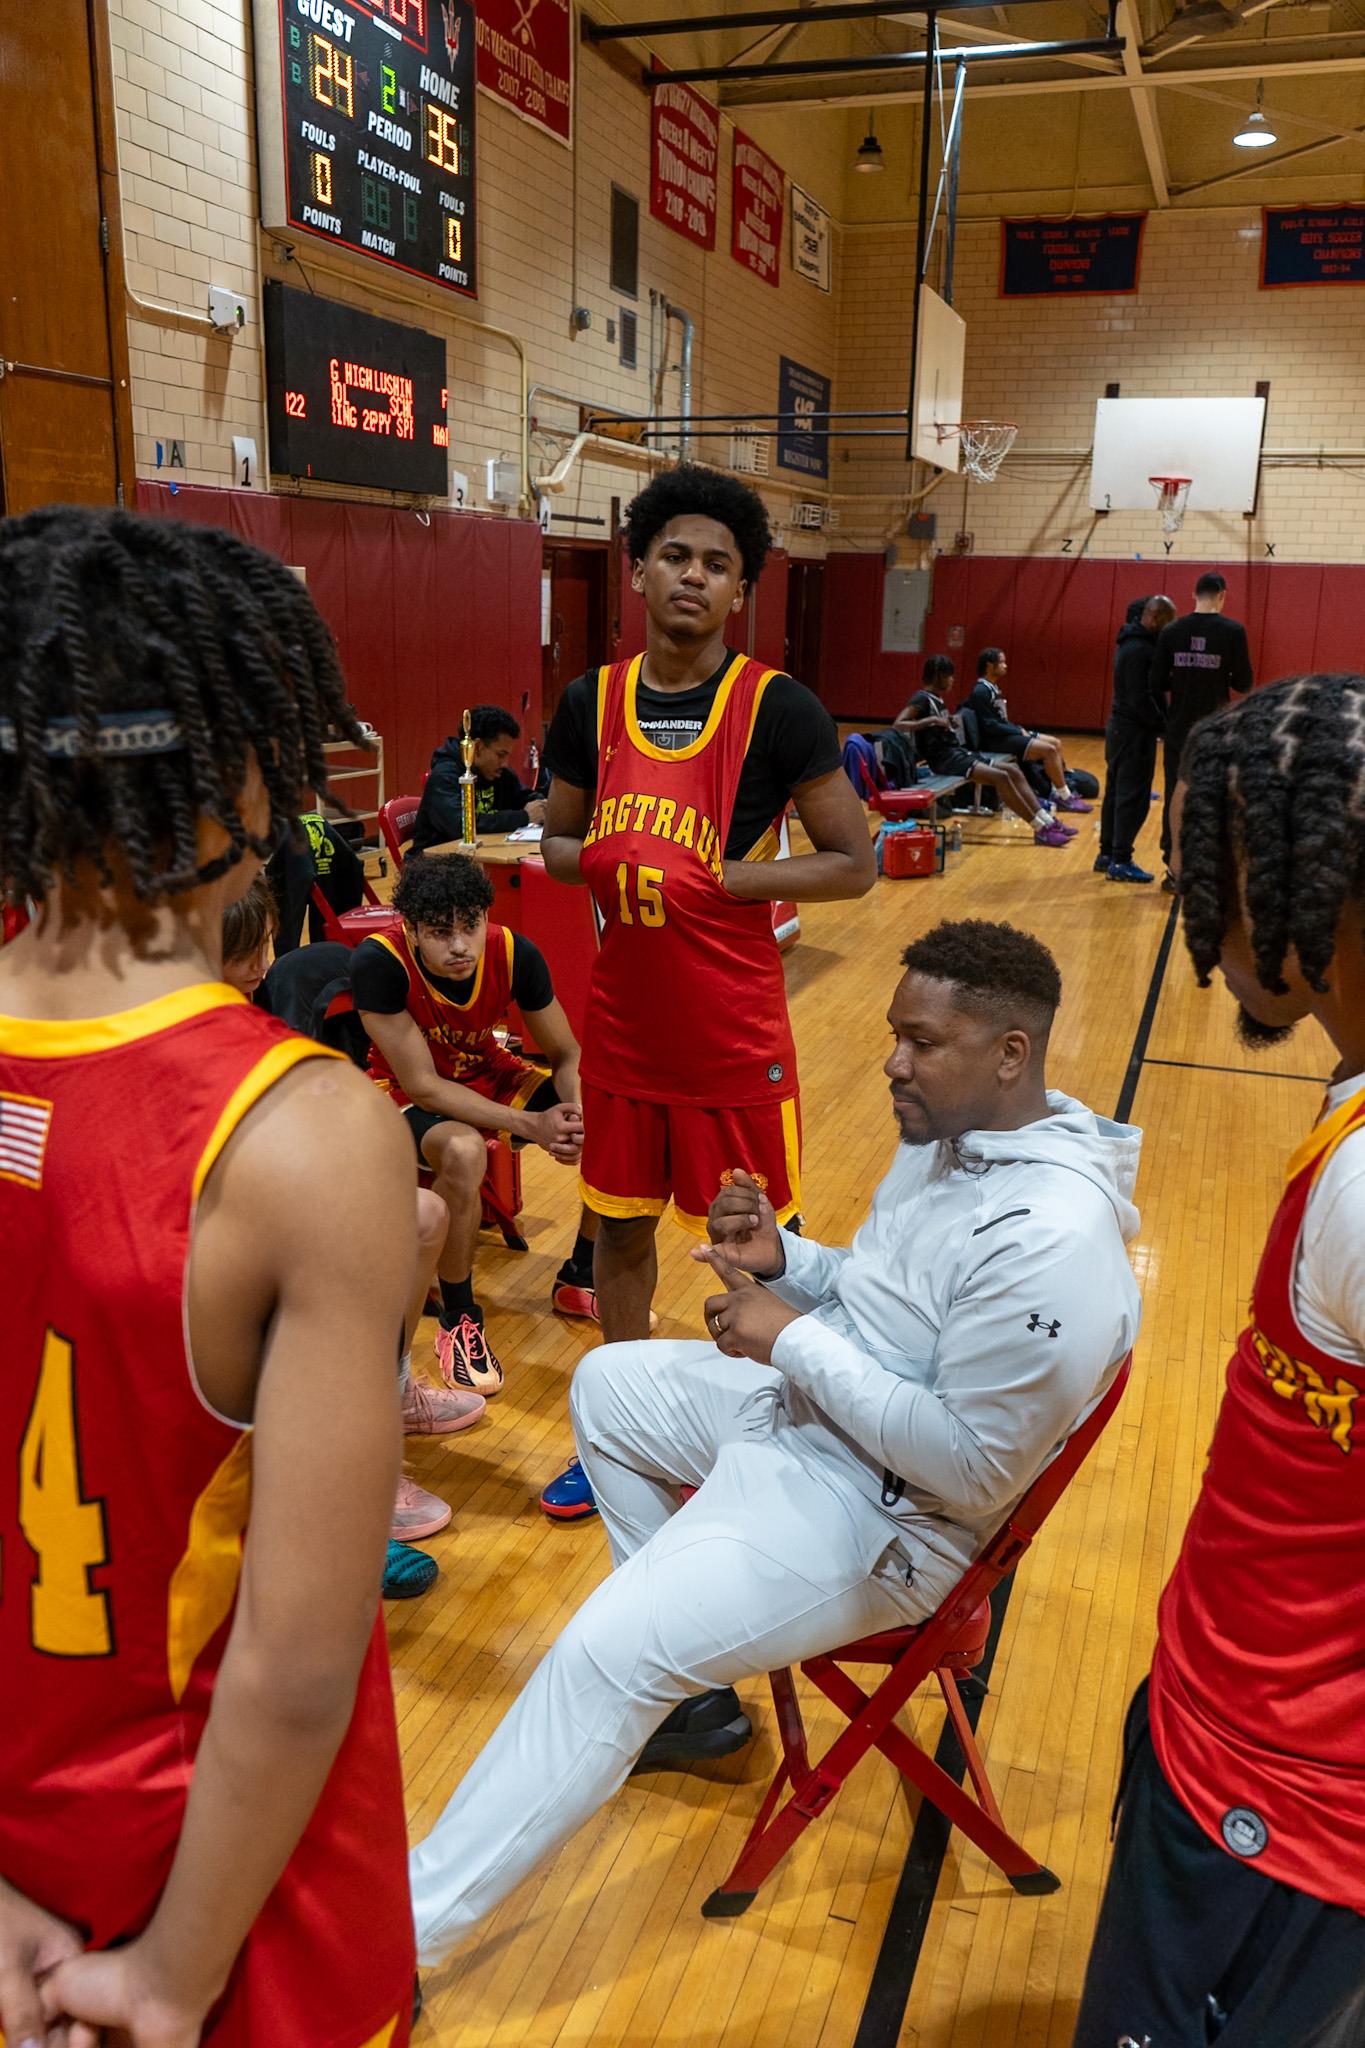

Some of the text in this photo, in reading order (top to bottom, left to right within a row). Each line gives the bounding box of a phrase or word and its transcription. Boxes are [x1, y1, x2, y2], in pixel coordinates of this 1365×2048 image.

[296, 0, 356, 43] GUEST
[312, 34, 354, 118] 24
[381, 64, 397, 115] 2
[419, 64, 461, 110] HOME
[301, 120, 336, 151] FOULS
[368, 110, 413, 152] PERIOD
[426, 104, 460, 175] 35
[314, 152, 332, 206] 0
[303, 205, 342, 236] POINTS
[438, 190, 465, 217] FOULS
[361, 229, 396, 257] MATCH
[447, 217, 462, 262] 0
[438, 262, 468, 287] POINTS
[344, 361, 374, 391] HIGH
[170, 440, 184, 468] A
[241, 456, 251, 487] 1
[1061, 538, 1276, 558] Z Y X
[616, 861, 668, 929] 15
